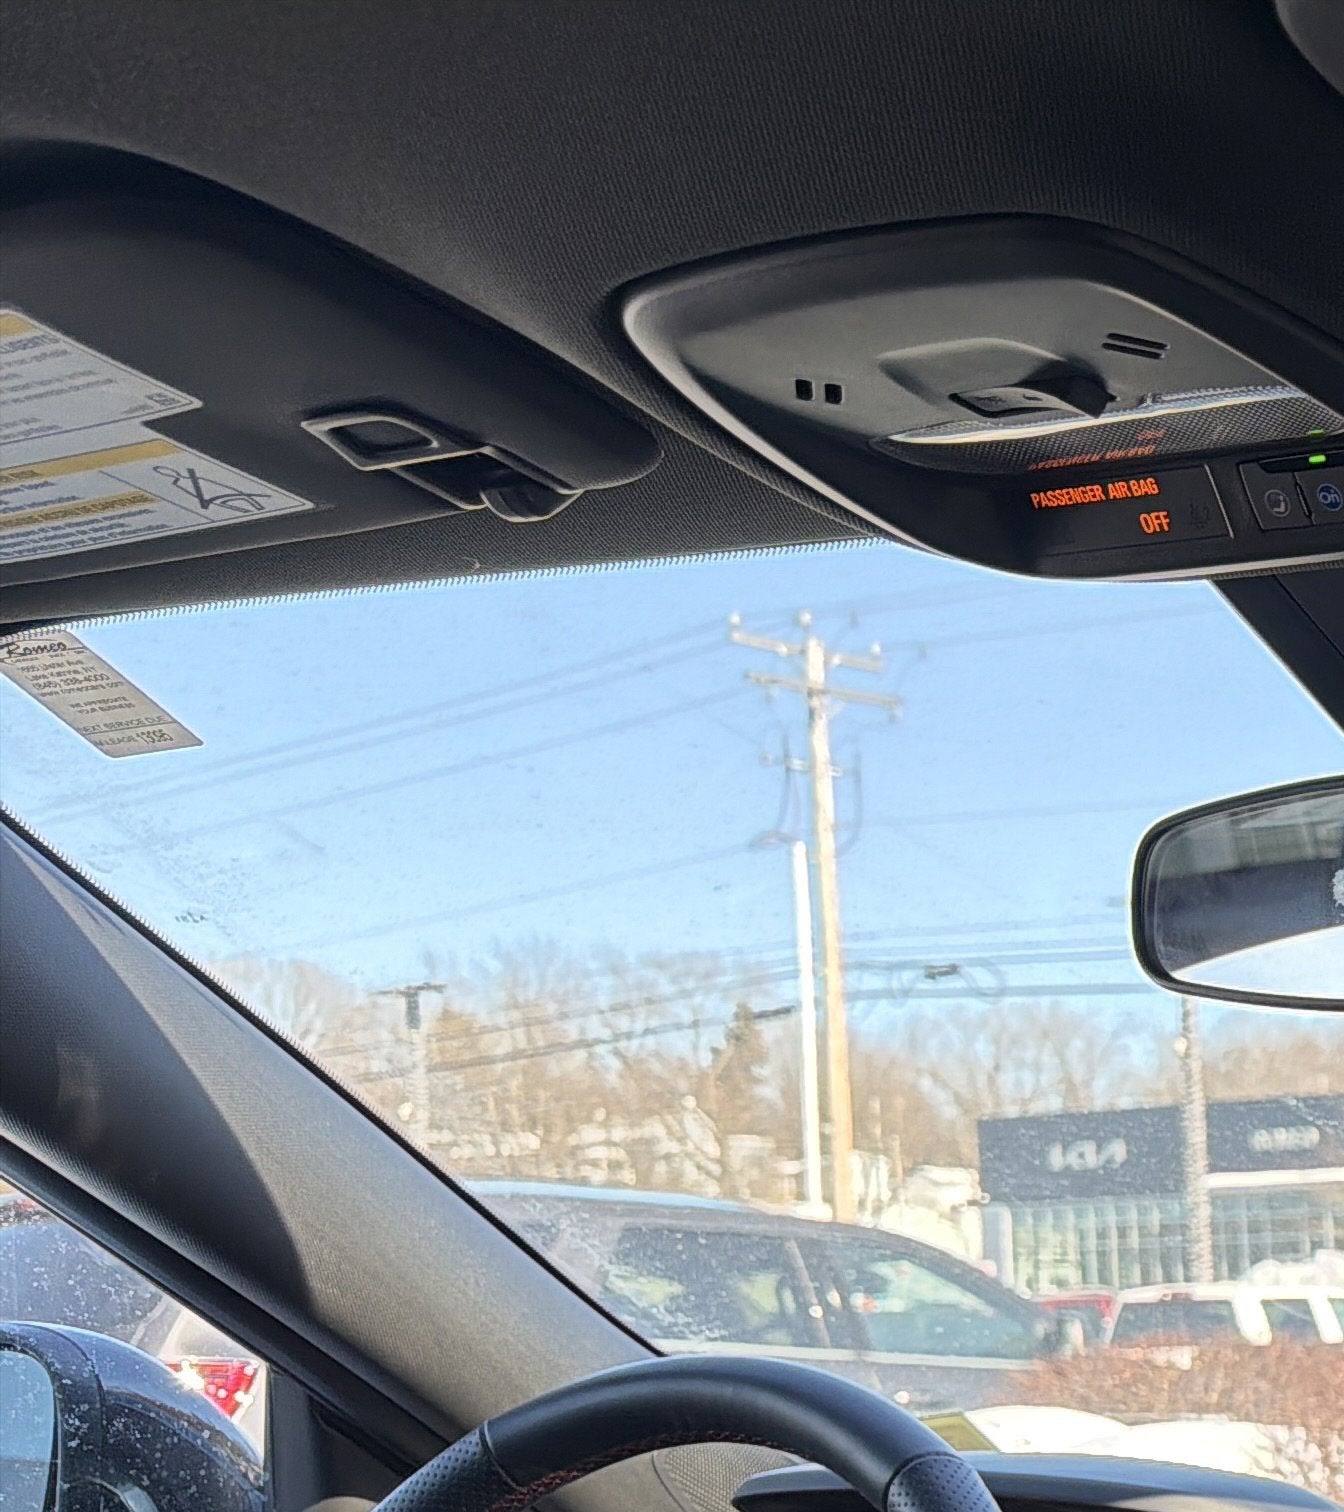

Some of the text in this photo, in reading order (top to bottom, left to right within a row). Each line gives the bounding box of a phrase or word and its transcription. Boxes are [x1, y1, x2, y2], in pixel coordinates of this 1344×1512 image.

[1030, 477, 1159, 509] PASSENGER AIR BAG
[1139, 511, 1170, 534] OFF
[104, 719, 144, 729] SERVICE
[145, 716, 168, 725] DUE
